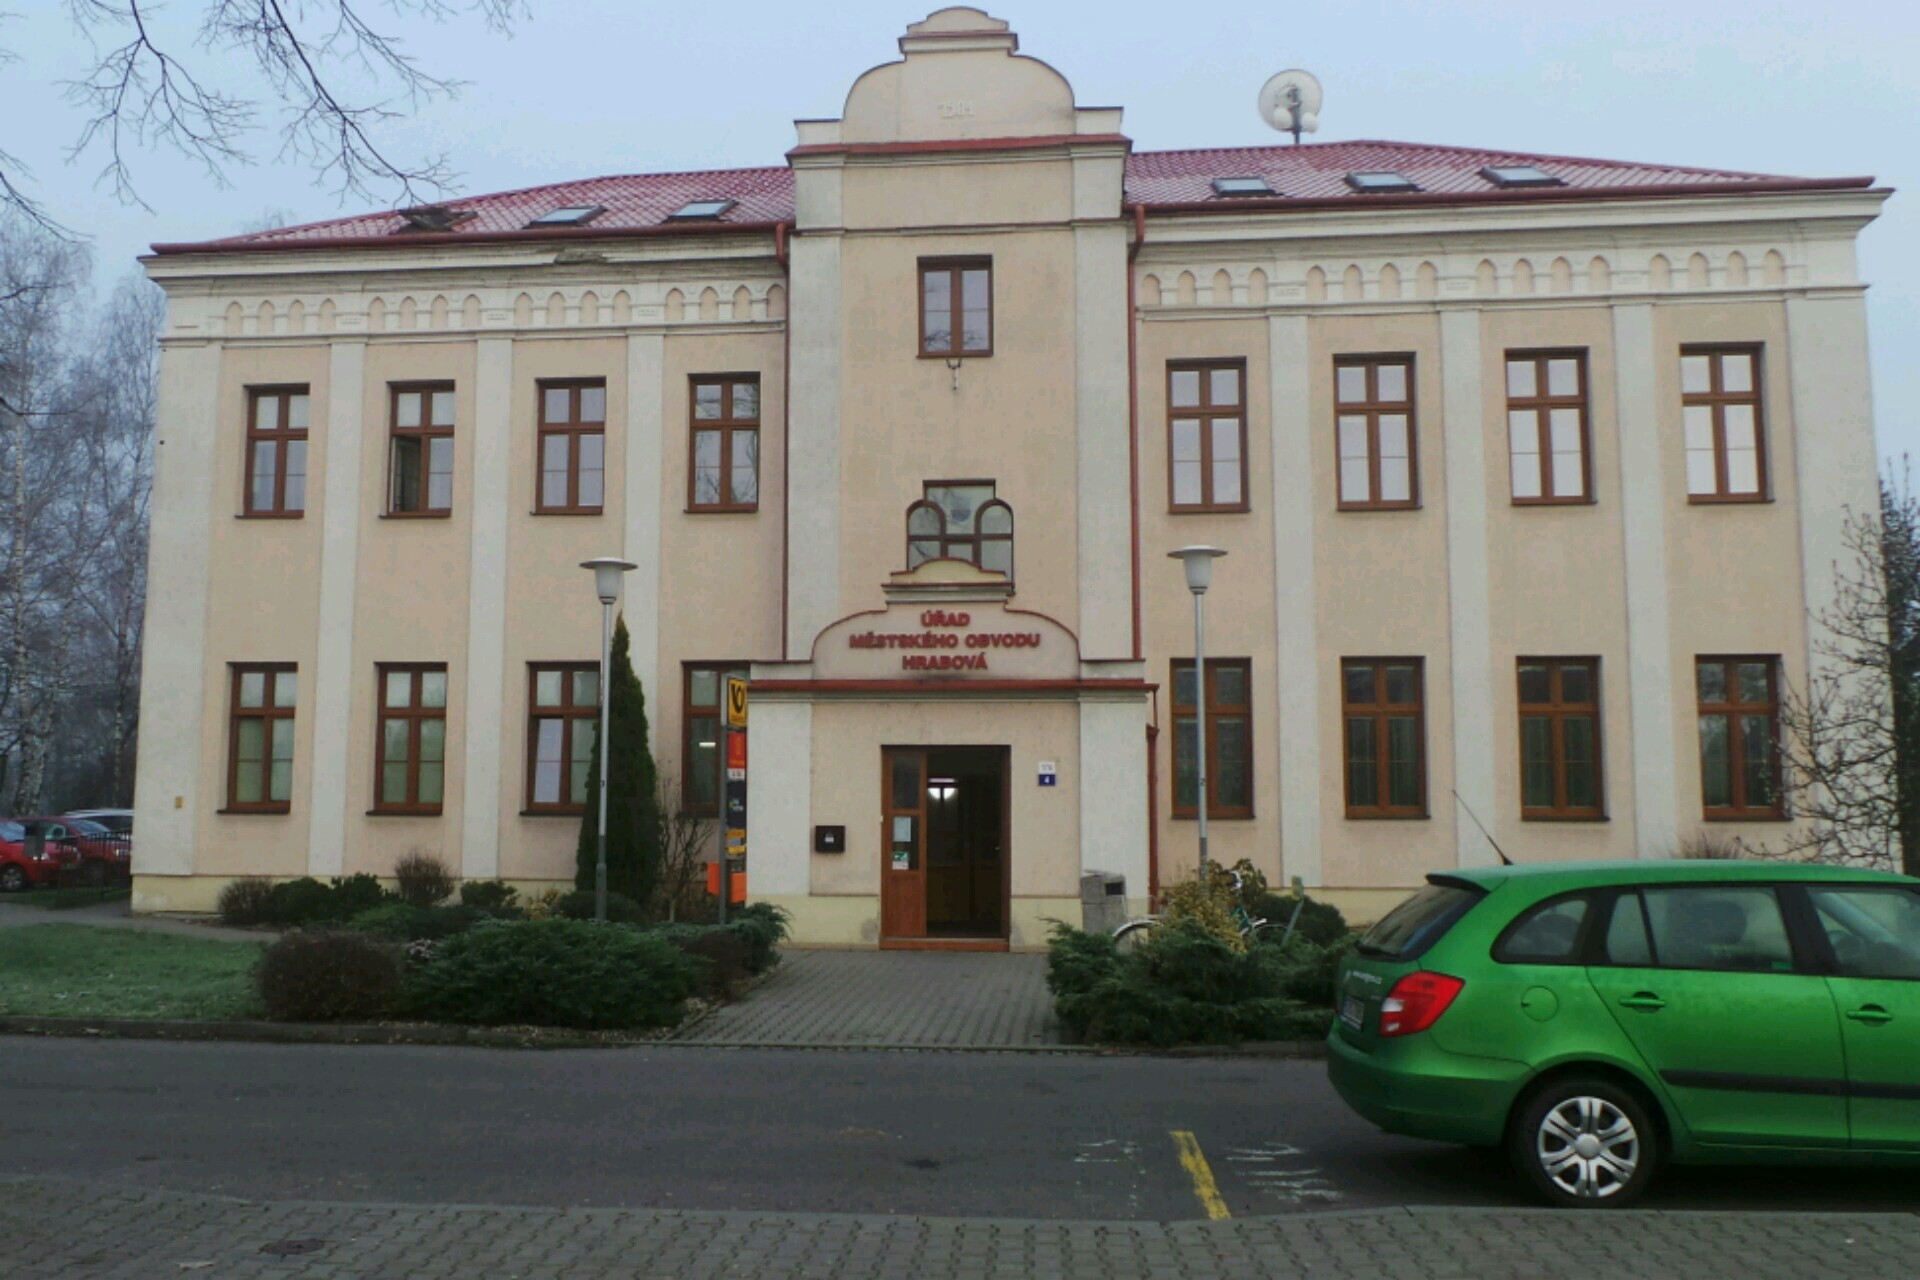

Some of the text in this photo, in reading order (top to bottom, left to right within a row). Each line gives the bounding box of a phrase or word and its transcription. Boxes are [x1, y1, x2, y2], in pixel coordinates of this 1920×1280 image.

[920, 609, 971, 627] ÚŘAD
[849, 631, 1041, 649] MĚSTSKÉHO OBVODU
[902, 652, 989, 670] HRABOVÁ
